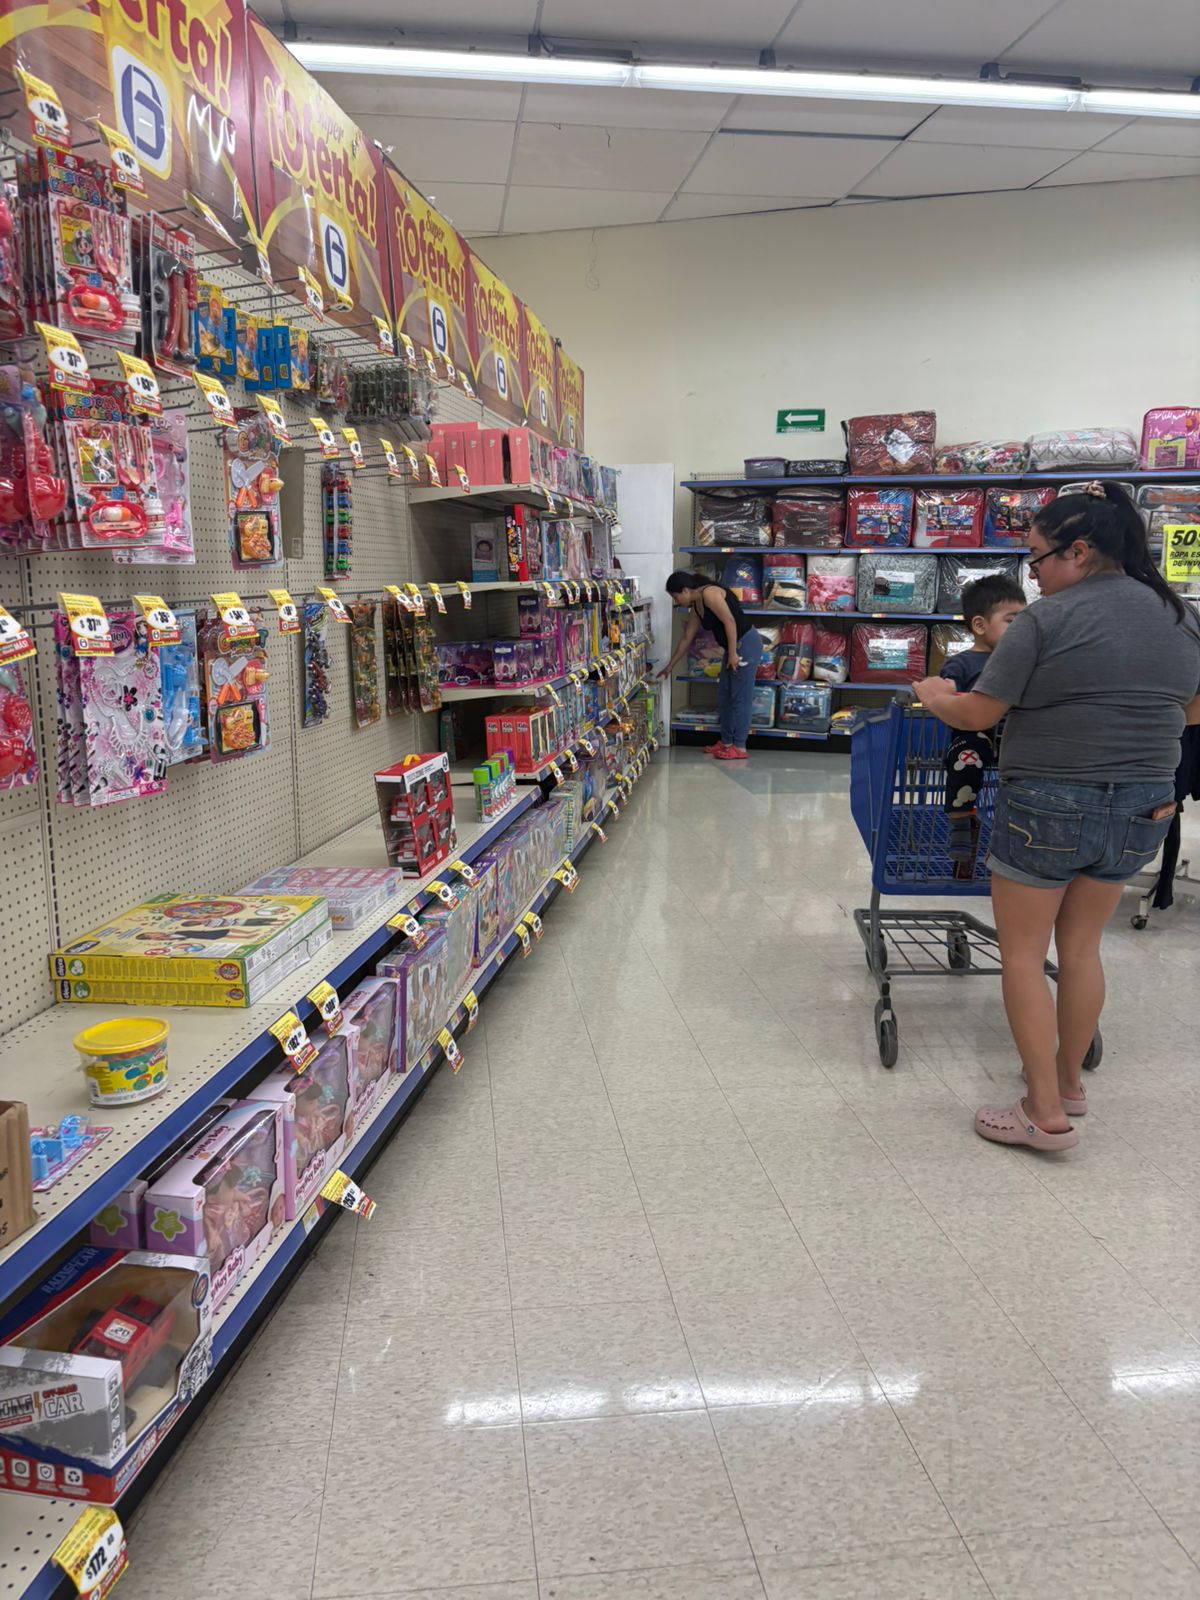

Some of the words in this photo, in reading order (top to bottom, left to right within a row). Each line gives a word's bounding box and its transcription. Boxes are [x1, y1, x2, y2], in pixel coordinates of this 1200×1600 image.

[426, 209, 445, 244] Super
[1171, 529, 1200, 546] 50
[44, 1392, 85, 1419] CAR
